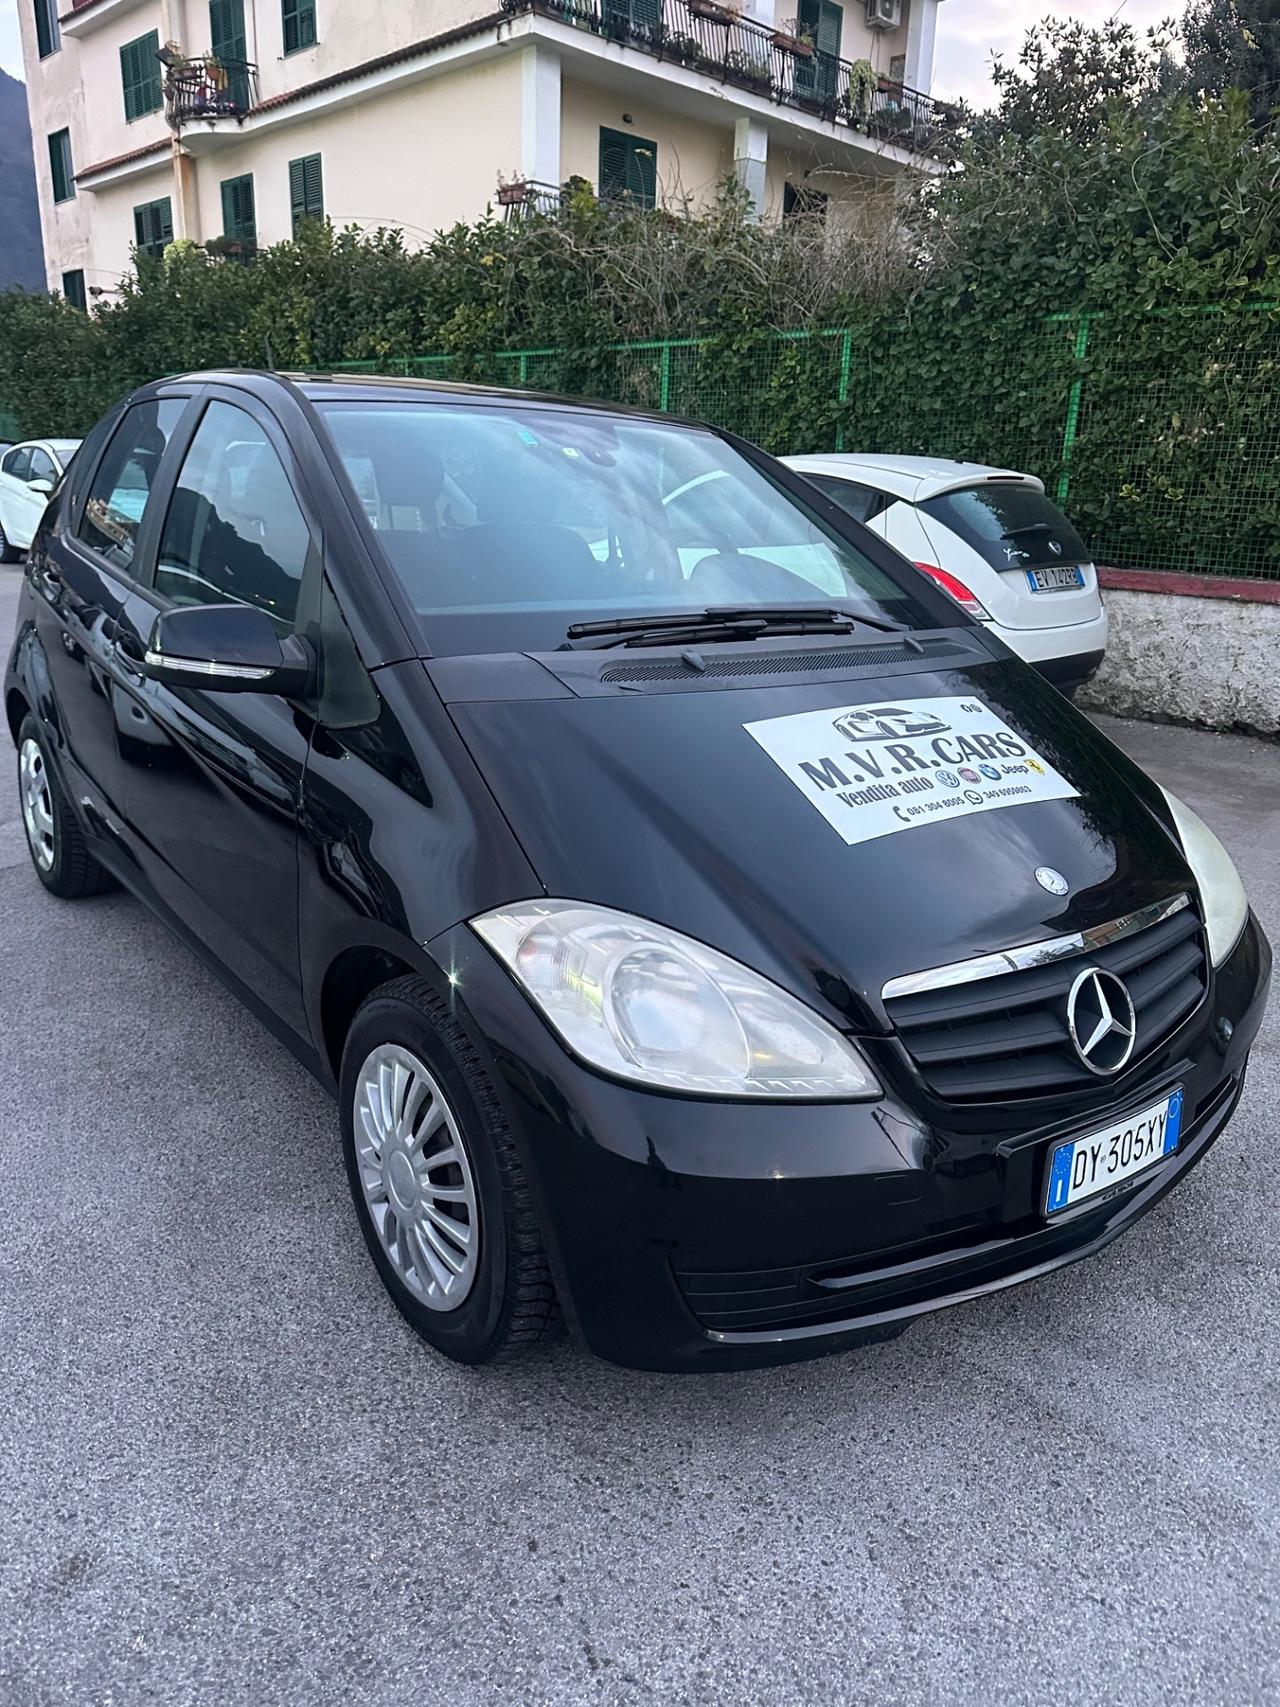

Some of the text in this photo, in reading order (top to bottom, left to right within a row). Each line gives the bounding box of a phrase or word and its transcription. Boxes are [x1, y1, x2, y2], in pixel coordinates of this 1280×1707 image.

[1035, 571, 1049, 588] EV
[1001, 763, 1029, 775] Jeep
[836, 782, 899, 808] Vendita
[898, 775, 935, 794] auto
[983, 788, 1000, 799] 349
[907, 796, 966, 816] 081 304 8005
[1072, 1111, 1167, 1190] DY 305XY
